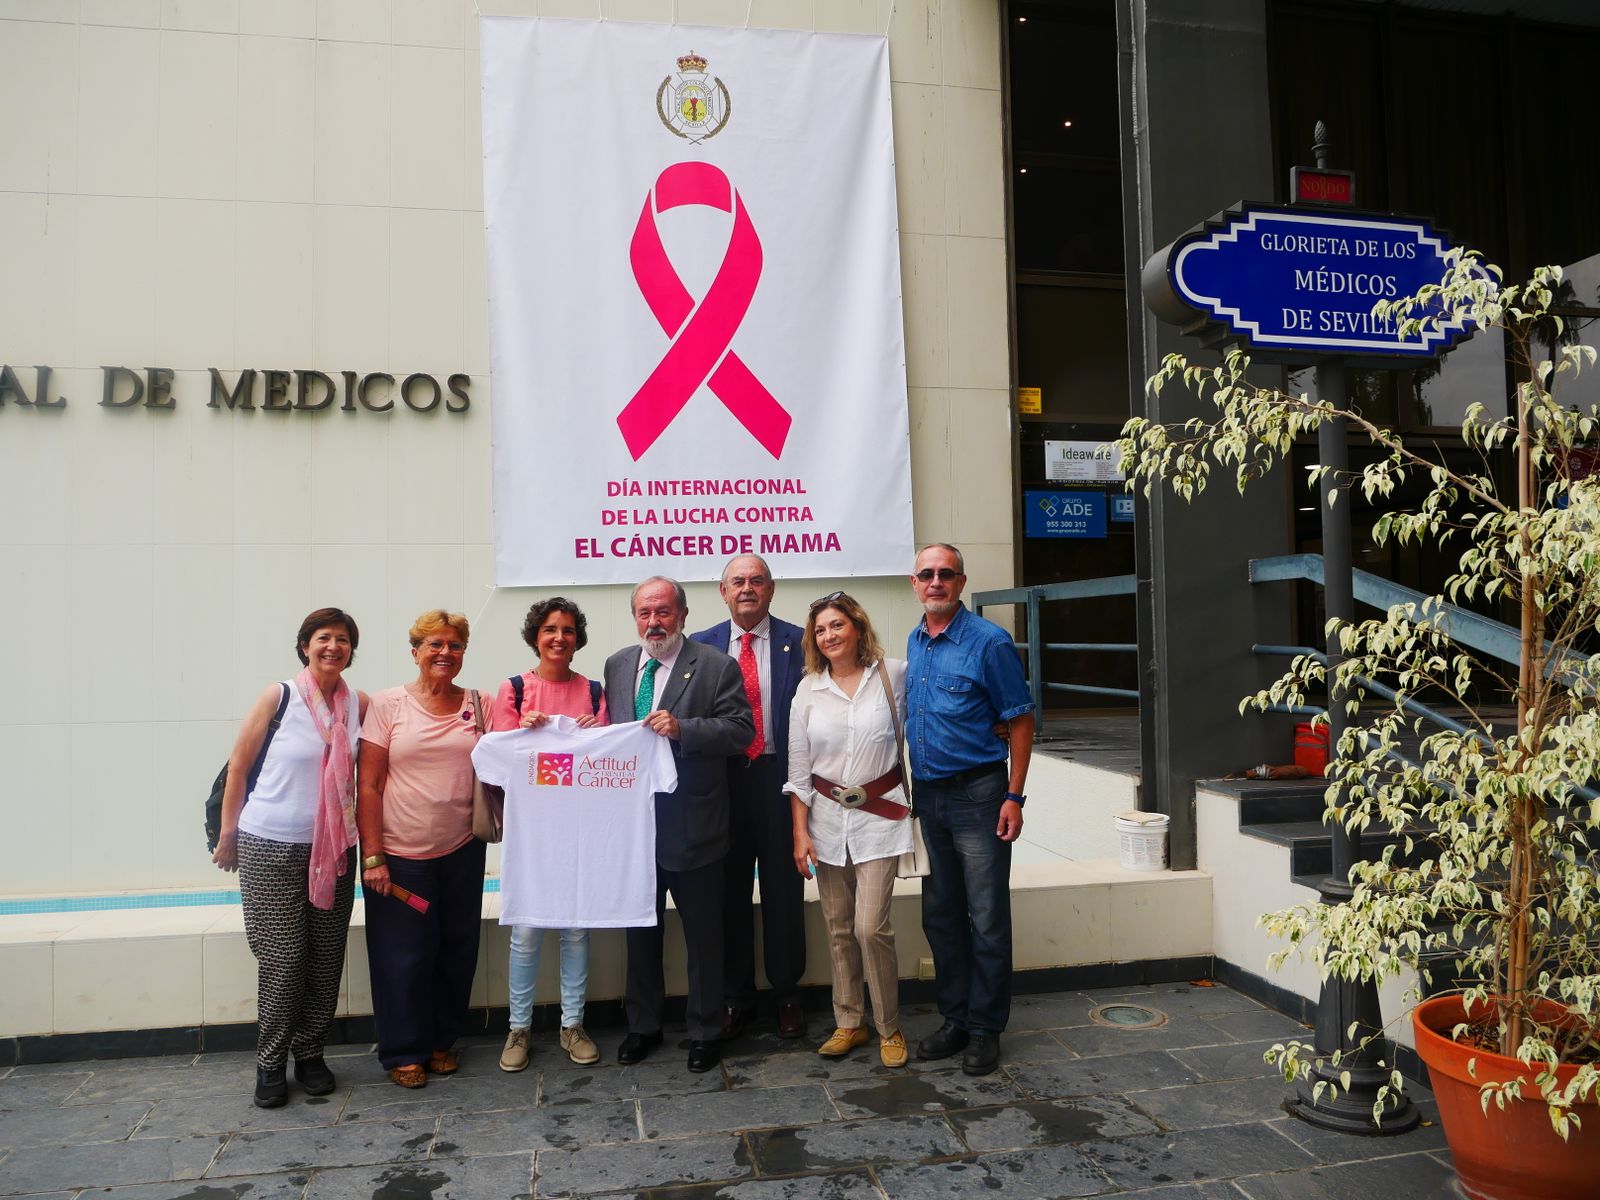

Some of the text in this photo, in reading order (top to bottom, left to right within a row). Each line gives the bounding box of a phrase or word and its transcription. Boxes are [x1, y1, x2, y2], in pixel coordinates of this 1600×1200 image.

[1260, 233, 1416, 260] GLORIETA DE LOS
[1294, 266, 1397, 297] MÉDICOS
[1282, 308, 1313, 331] DE
[97, 364, 176, 409] DE
[206, 366, 471, 413] MEDICOS
[607, 478, 807, 496] DÍA INTERNACIONAL
[601, 506, 814, 526] DE LA LUCHA CONTRA
[1062, 504, 1093, 516] ADE
[575, 532, 842, 559] EL CÁNCER DE MAMA
[579, 755, 638, 771] Actitud
[577, 771, 636, 789] Cáncer
